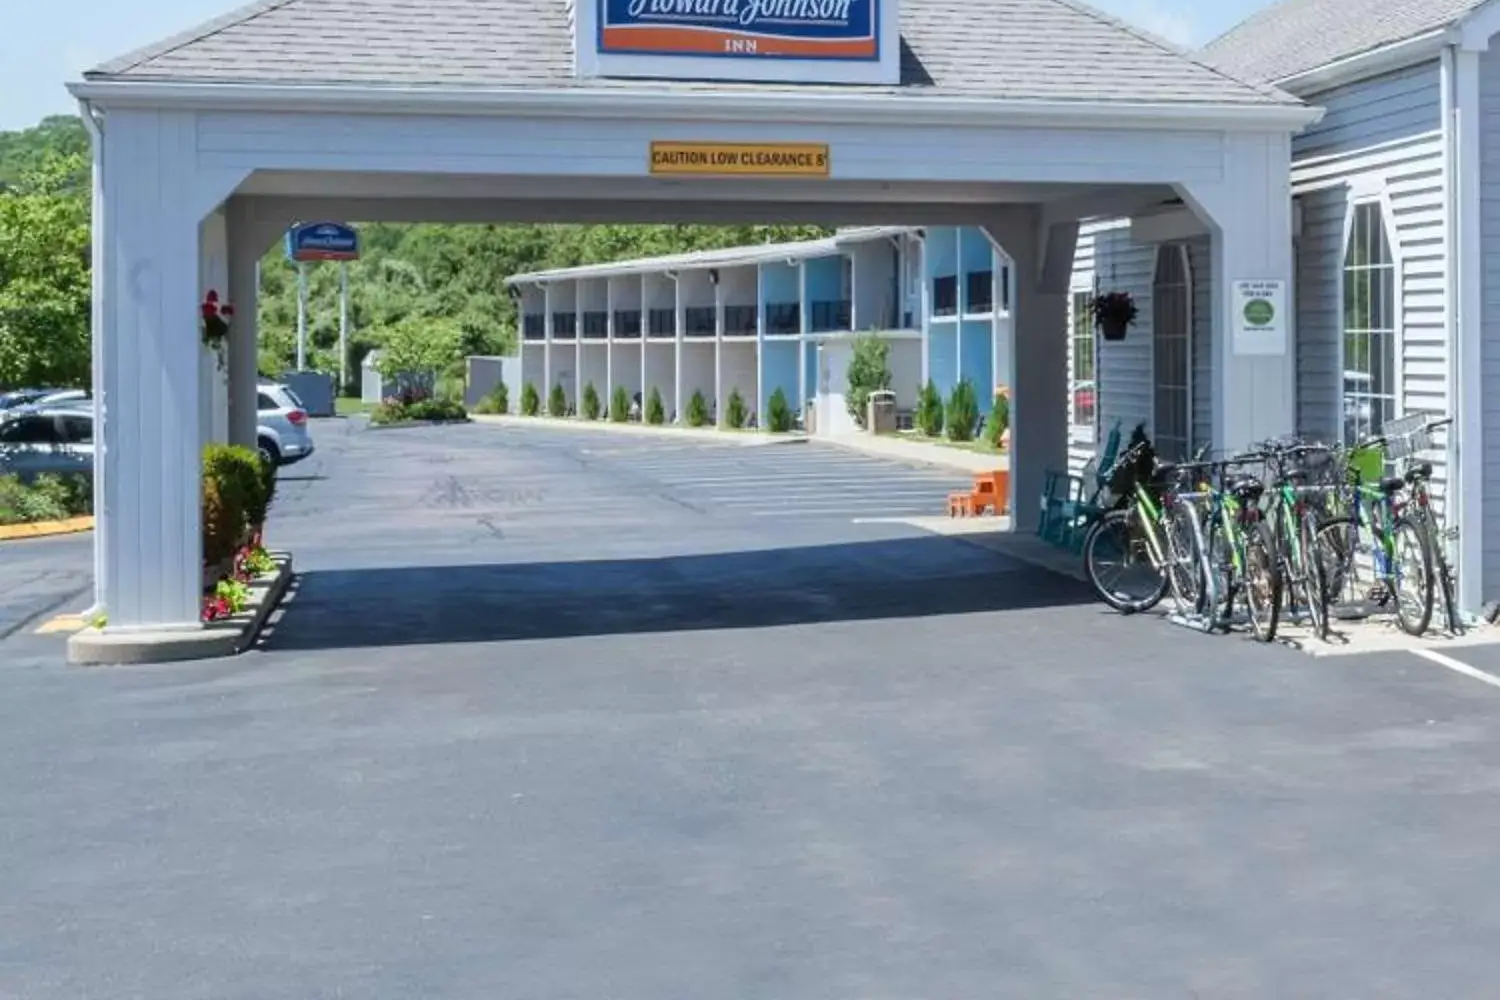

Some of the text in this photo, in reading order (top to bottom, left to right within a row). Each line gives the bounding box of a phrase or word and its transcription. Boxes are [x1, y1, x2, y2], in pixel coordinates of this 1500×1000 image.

[724, 39, 757, 53] INN
[652, 151, 706, 165] CAUTION
[711, 152, 739, 165] LOW
[741, 152, 813, 167] CLEARANCE
